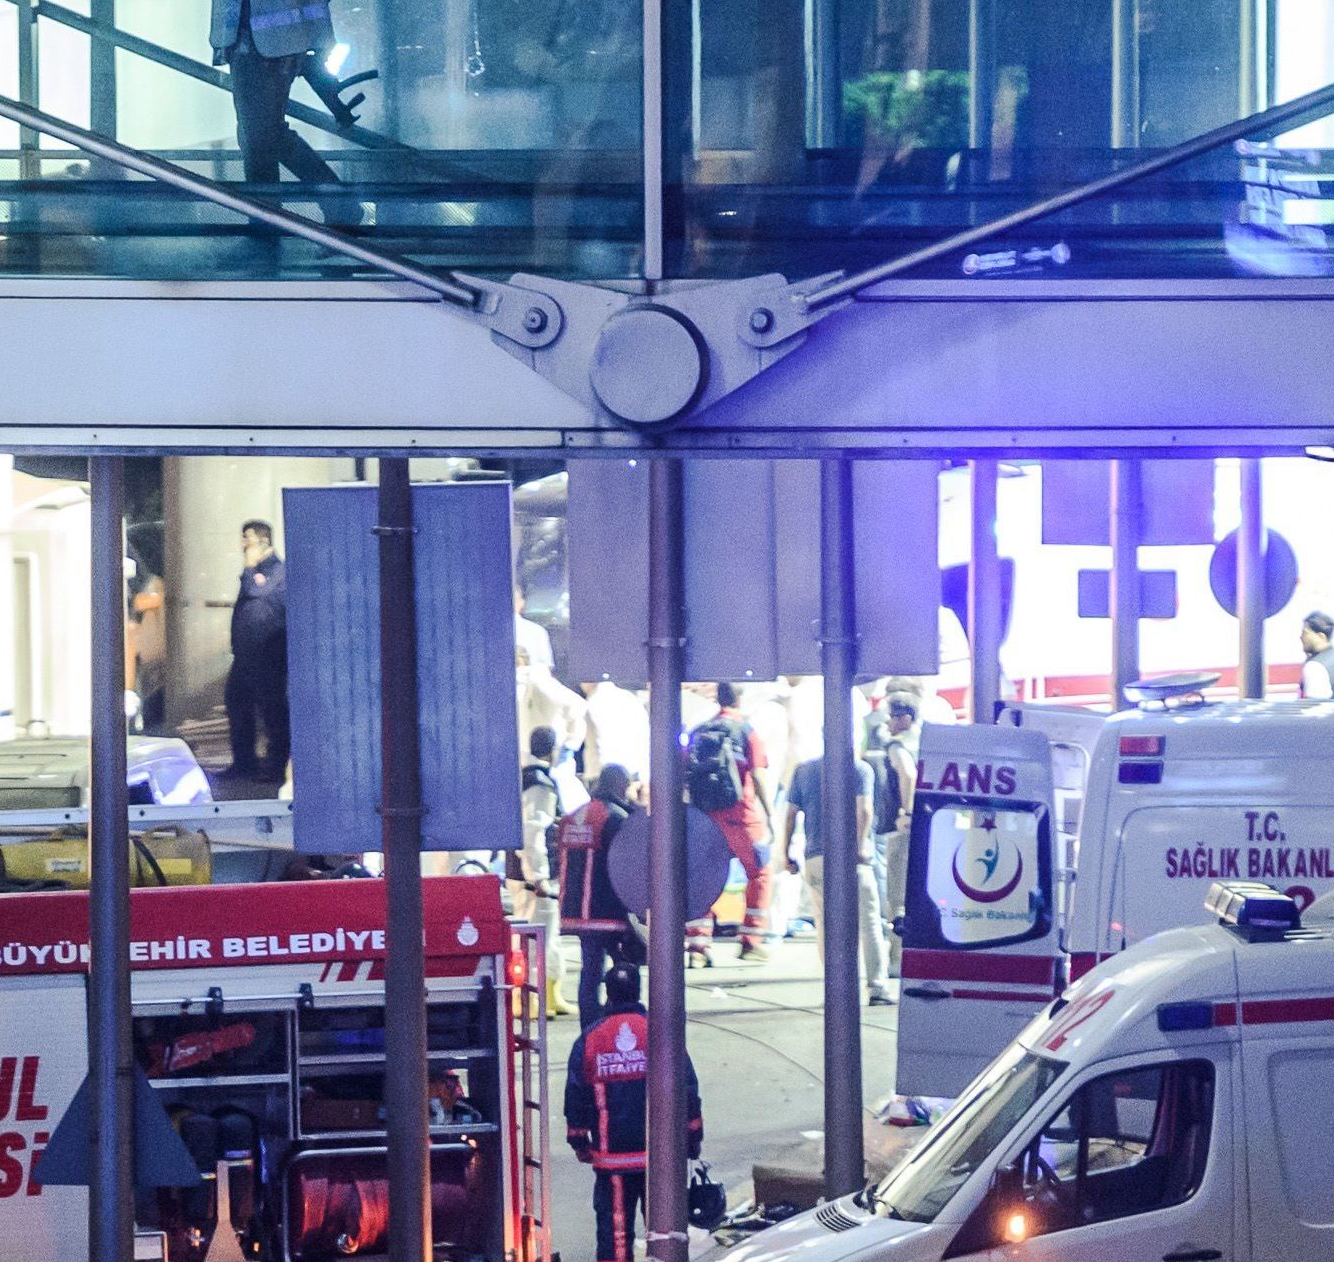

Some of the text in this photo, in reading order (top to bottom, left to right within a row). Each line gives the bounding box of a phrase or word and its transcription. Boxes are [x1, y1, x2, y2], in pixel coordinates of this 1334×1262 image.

[1244, 810, 1286, 842] T.C.
[1165, 841, 1241, 879] SAĞLIK
[222, 927, 387, 958] BELEDİYE
